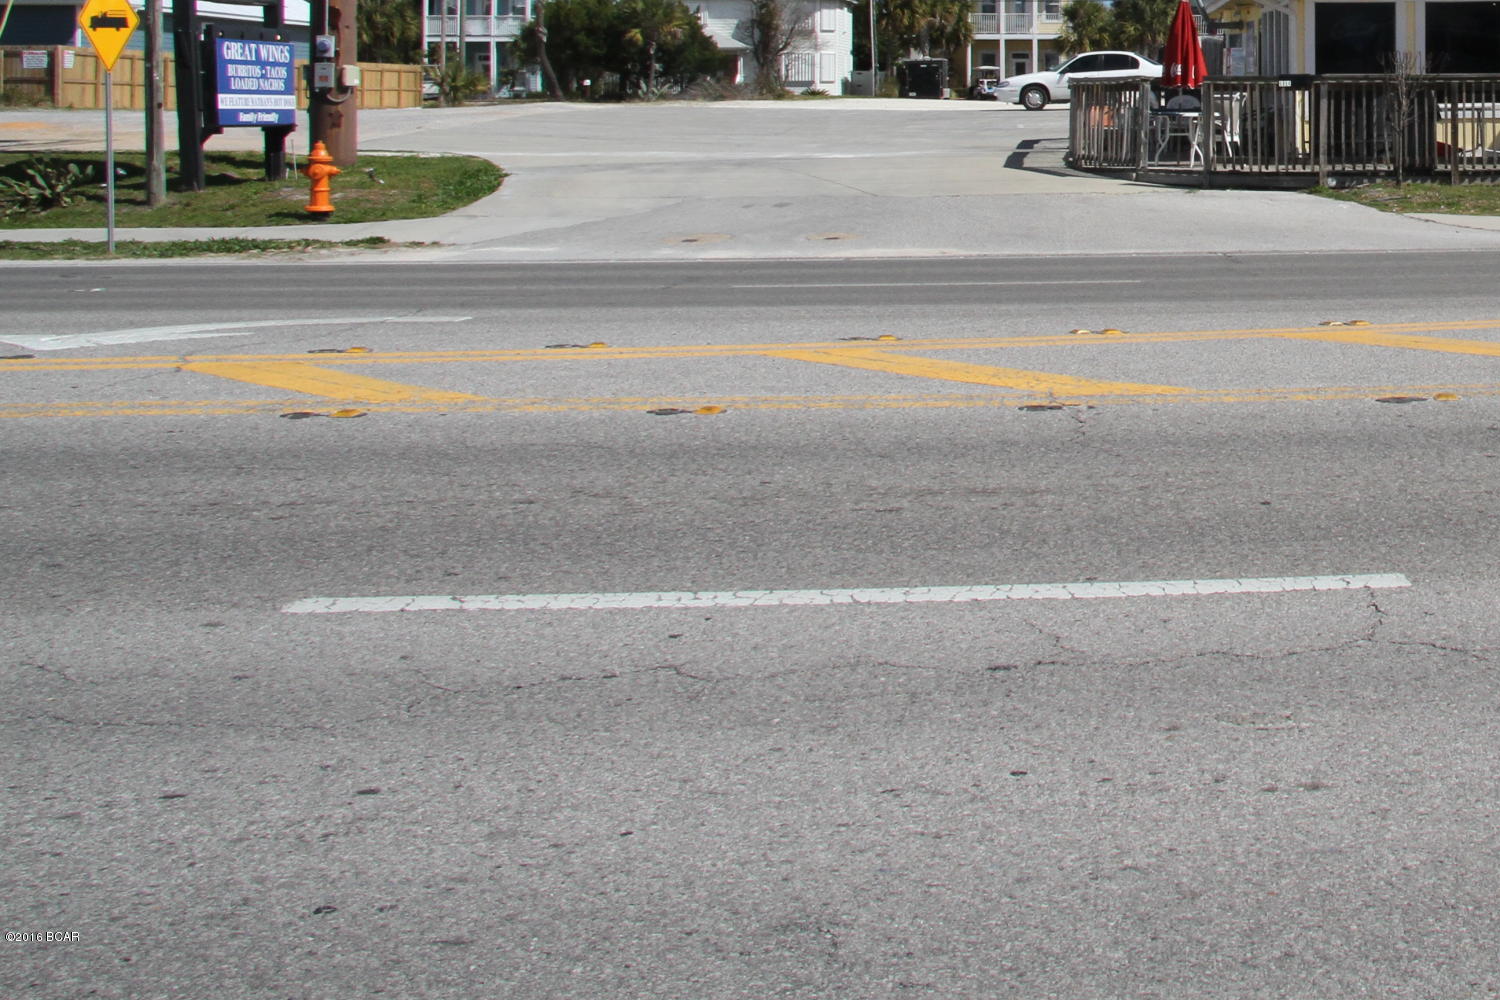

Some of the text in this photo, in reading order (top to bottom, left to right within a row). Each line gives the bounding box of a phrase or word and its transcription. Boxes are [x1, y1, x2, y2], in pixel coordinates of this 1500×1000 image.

[223, 41, 290, 63] GREAT WINGS
[226, 64, 287, 79] BURRITOS TACOS
[230, 77, 285, 91] LOADED NACHOS
